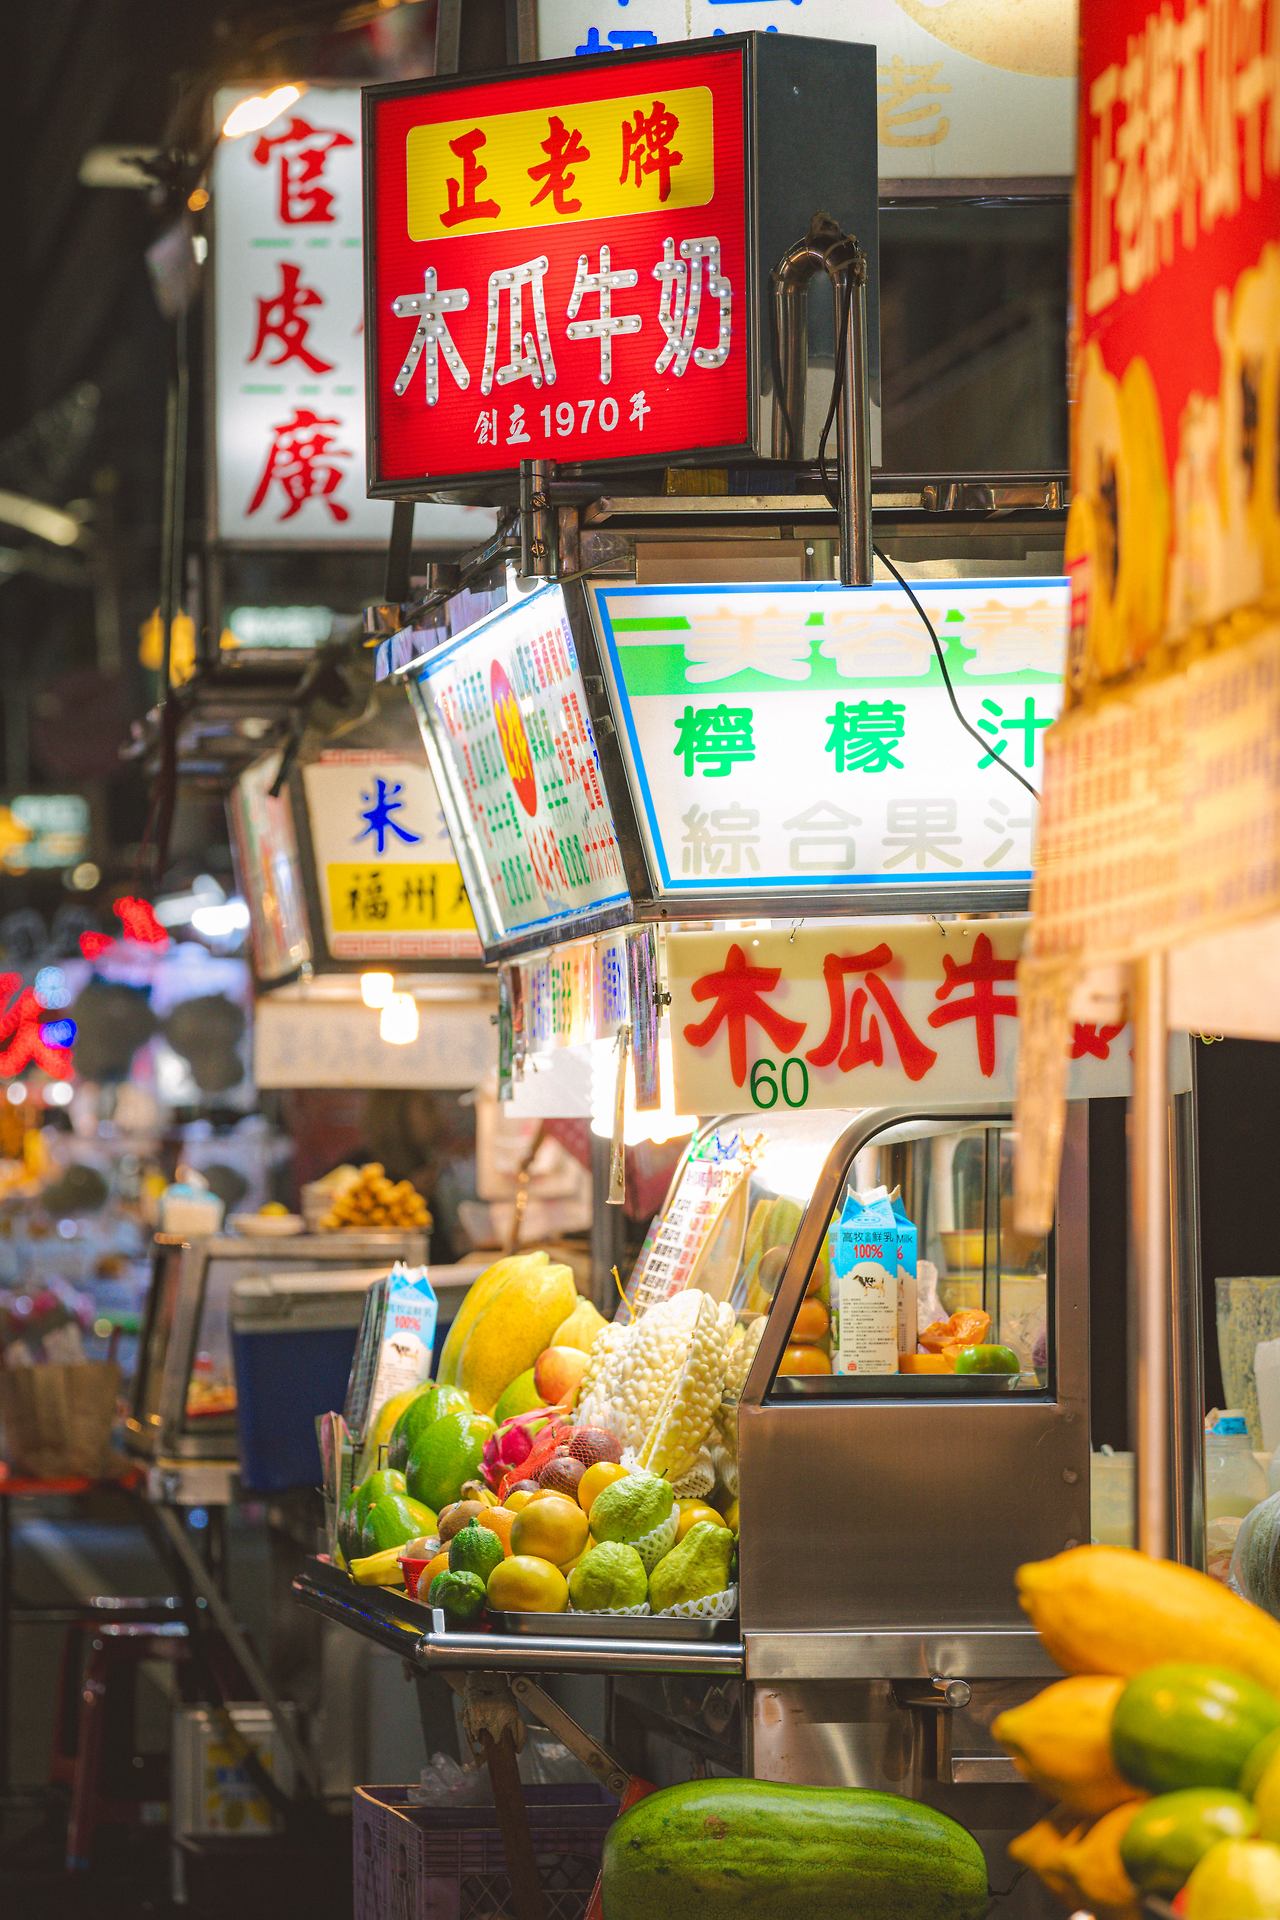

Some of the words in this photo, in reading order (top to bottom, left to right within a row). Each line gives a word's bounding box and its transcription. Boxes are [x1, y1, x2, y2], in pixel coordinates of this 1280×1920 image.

[439, 101, 684, 228] 正老牌
[392, 236, 733, 407] 木瓜牛奶
[473, 390, 651, 446] 創立1970年
[673, 697, 1055, 778] 檸檬汁
[348, 871, 468, 922] 福州
[749, 1057, 809, 1109] 60
[853, 1244, 883, 1259] 100%
